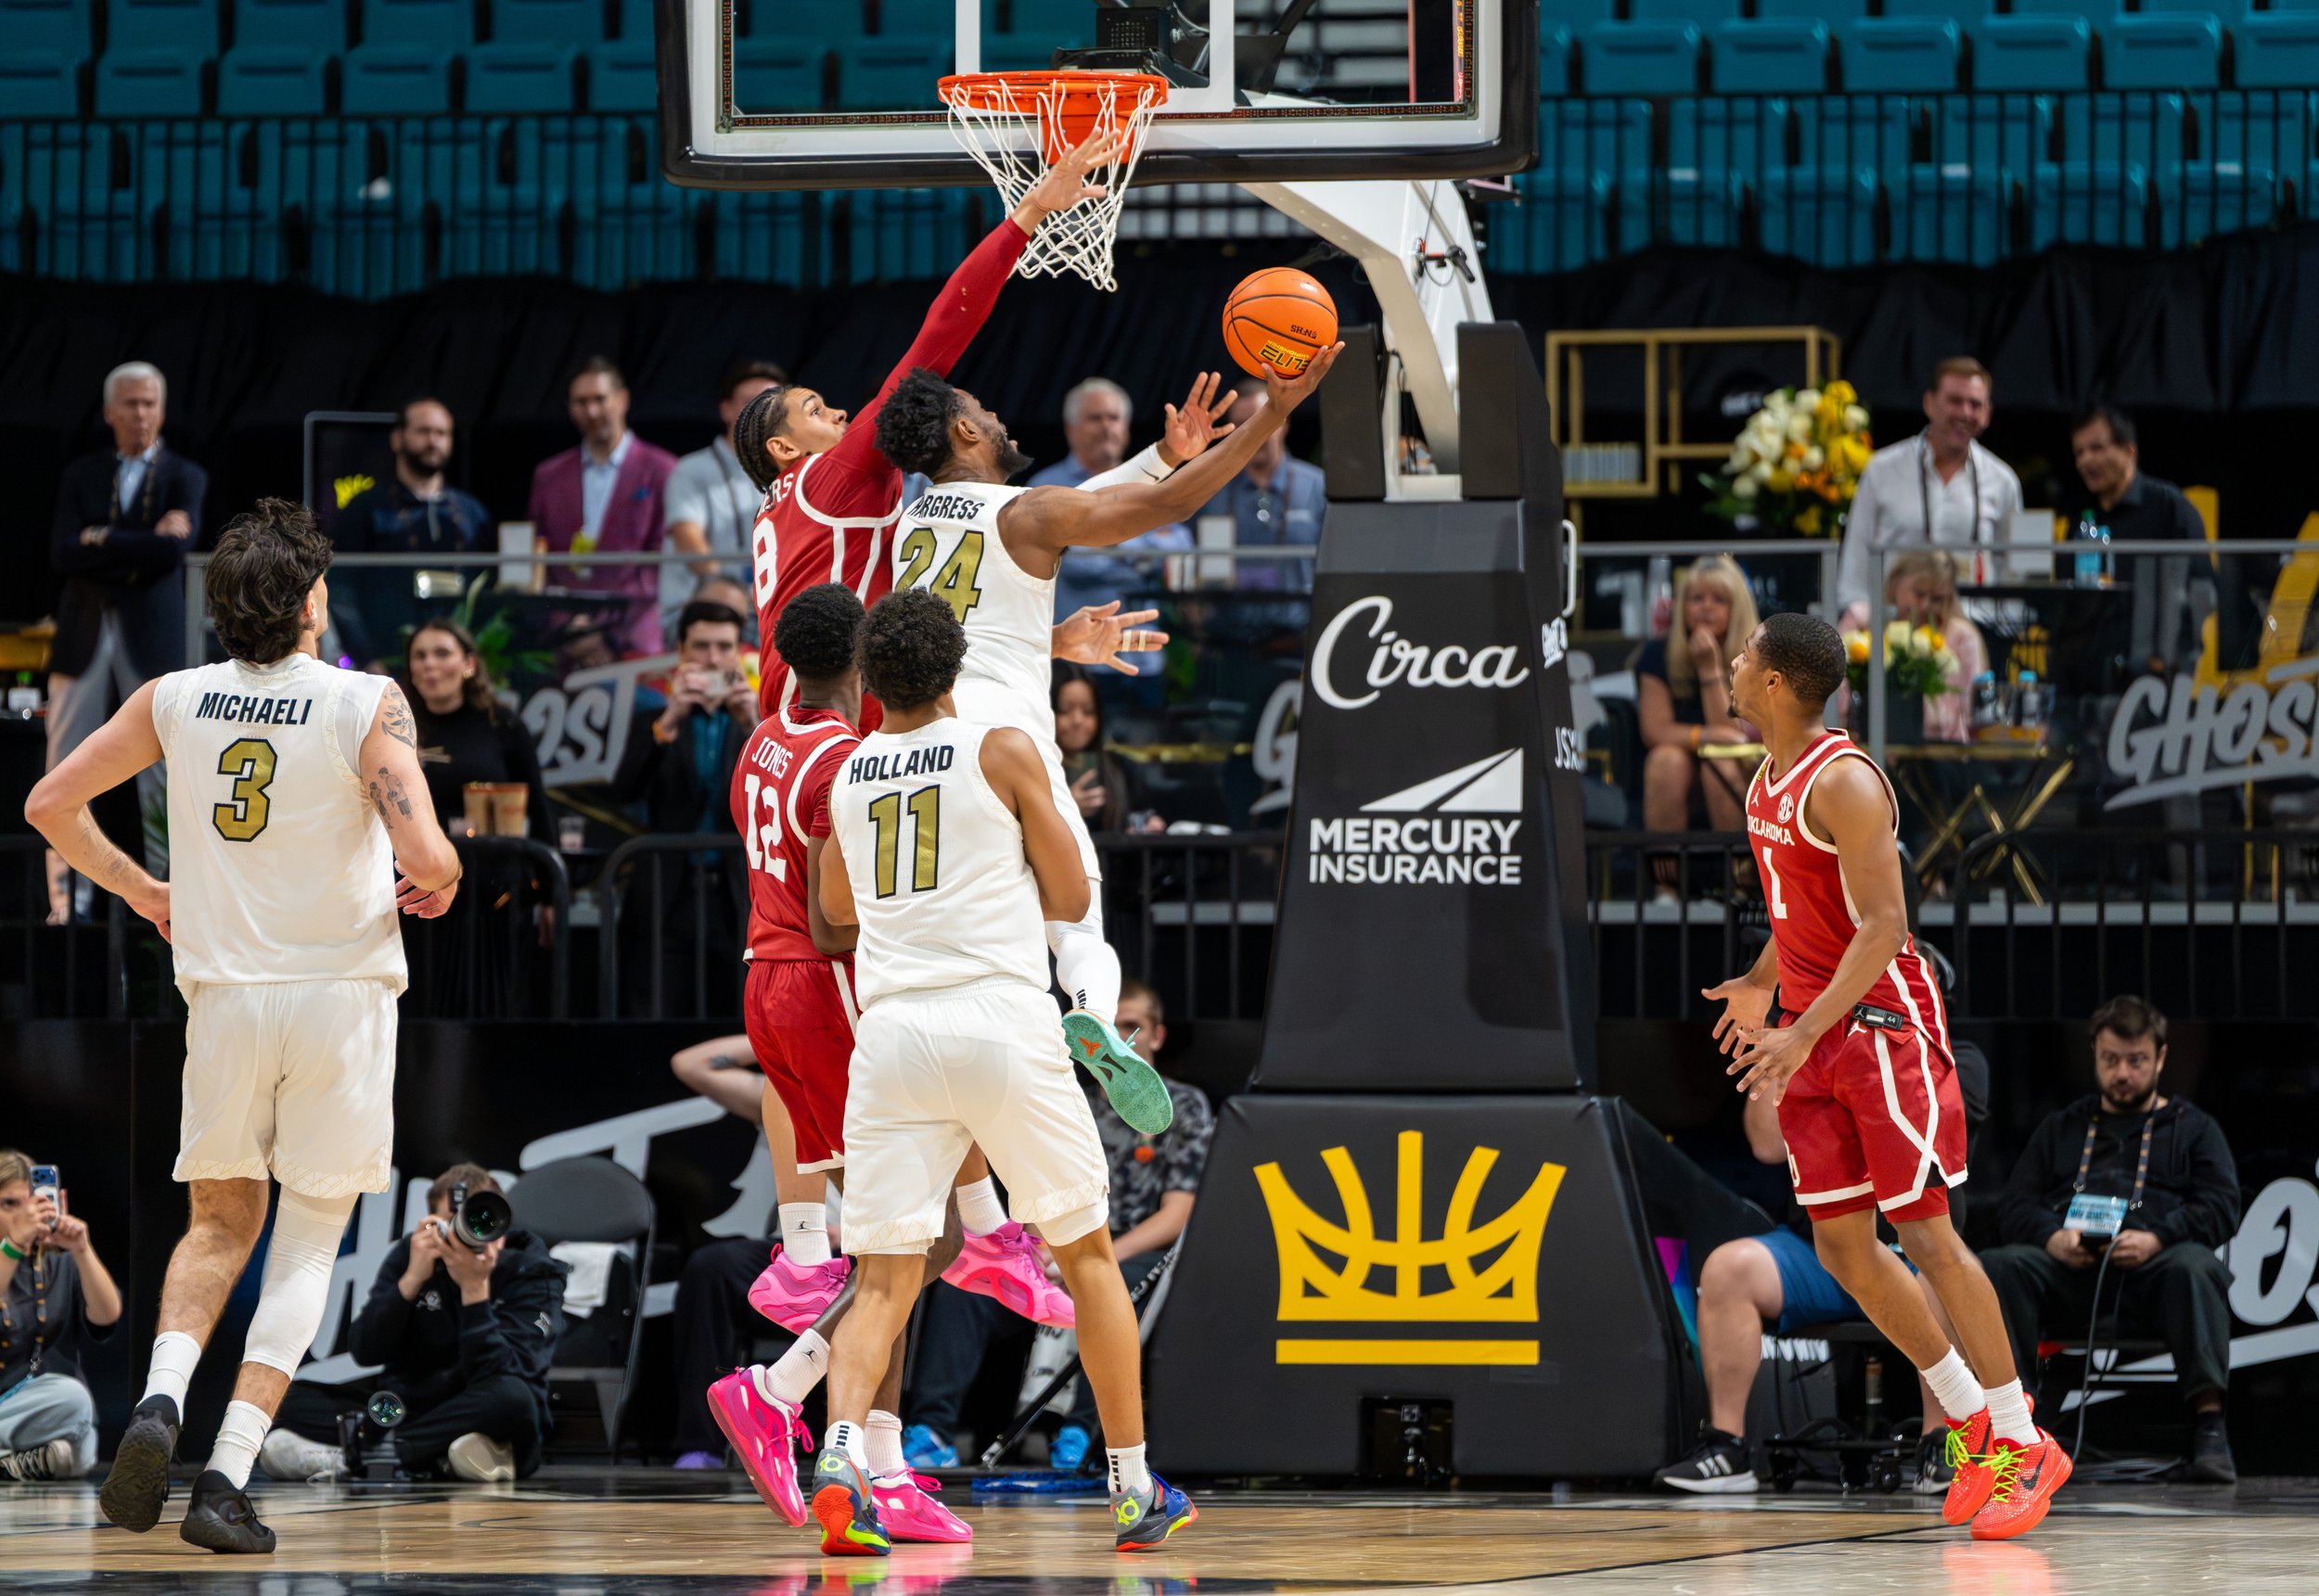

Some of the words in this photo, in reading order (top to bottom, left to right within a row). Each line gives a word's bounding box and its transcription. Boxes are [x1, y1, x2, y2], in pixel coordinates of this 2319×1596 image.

[1290, 325, 1312, 338] NFHS
[1259, 343, 1312, 371] ELITE
[752, 517, 777, 610] 8
[895, 527, 984, 626] 24
[1311, 595, 1530, 709] Circa
[196, 692, 313, 725] MICHAELI
[751, 737, 793, 780] JONES
[849, 745, 954, 785] HOLLAND
[212, 737, 277, 842] 3
[745, 772, 787, 883] 12
[868, 784, 940, 900] 11
[1310, 818, 1522, 853] MERCURY
[1748, 814, 1795, 846] OKLAHOMA
[1309, 854, 1522, 885] INSURANCE
[1763, 846, 1787, 919] 1
